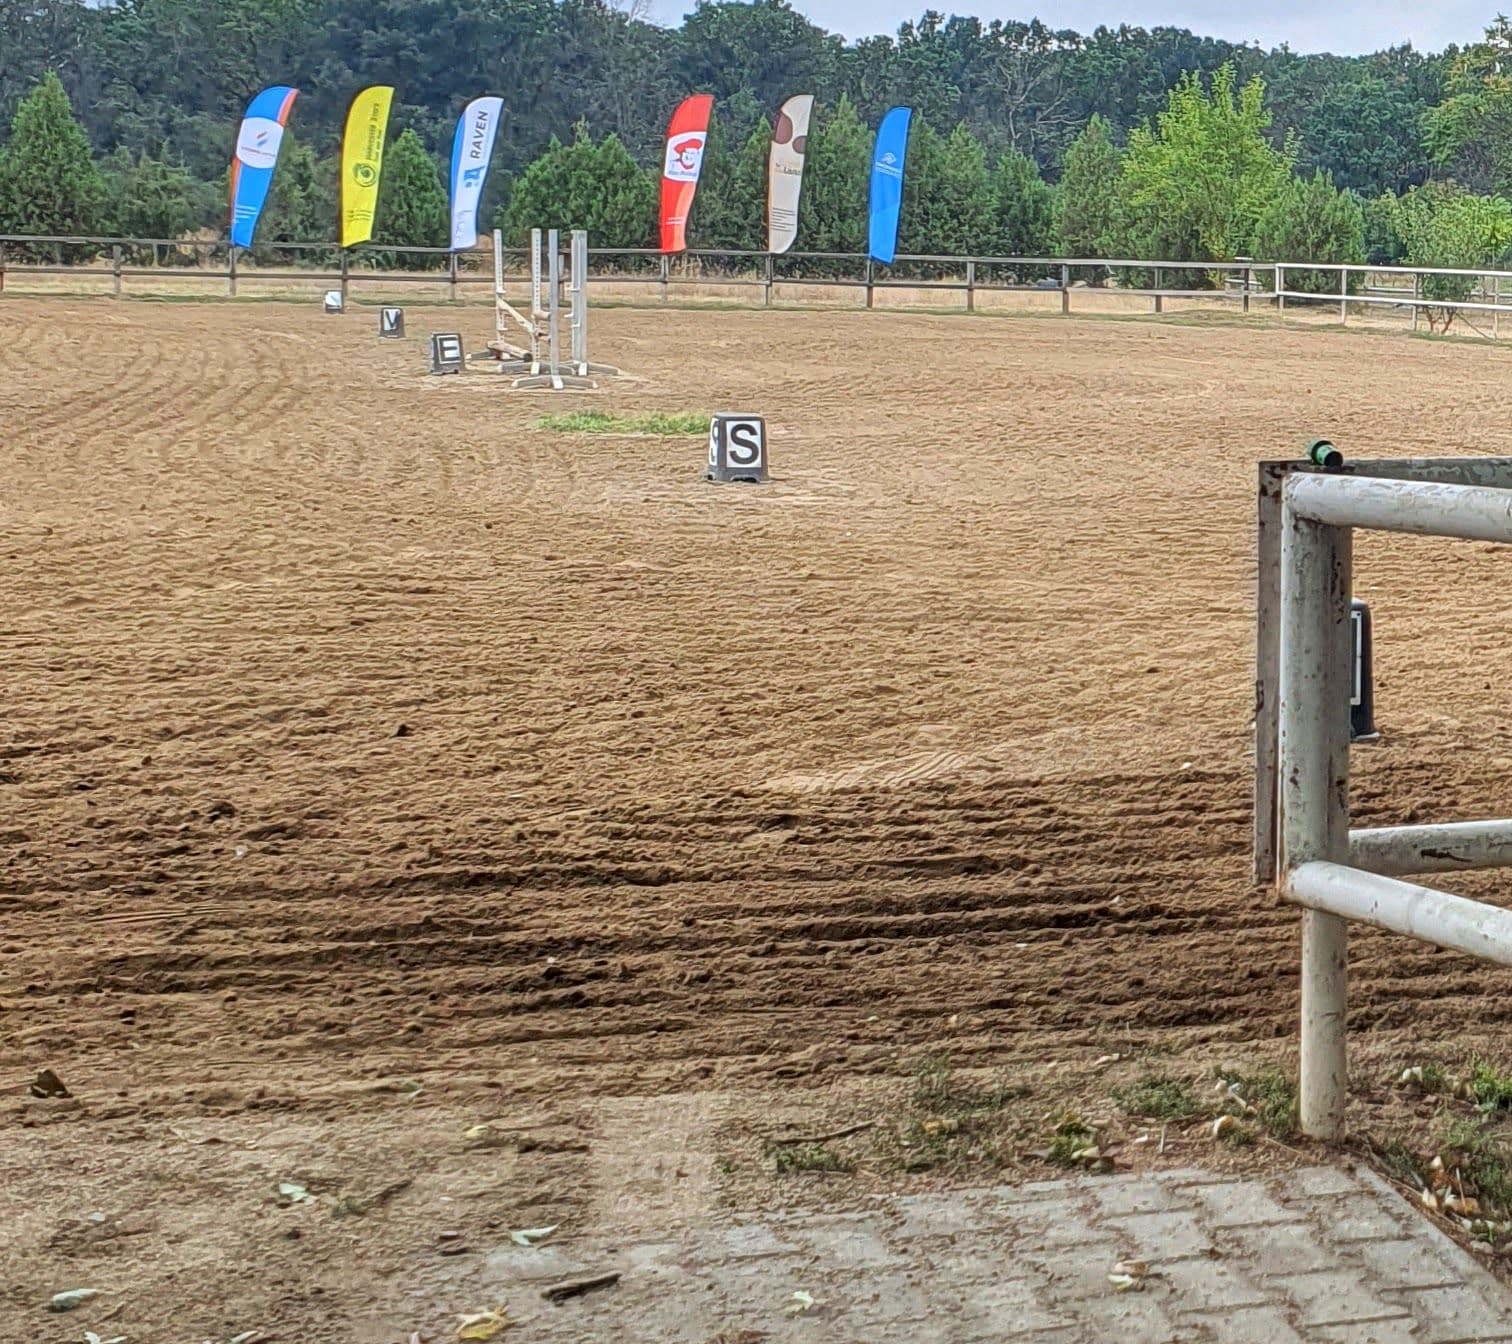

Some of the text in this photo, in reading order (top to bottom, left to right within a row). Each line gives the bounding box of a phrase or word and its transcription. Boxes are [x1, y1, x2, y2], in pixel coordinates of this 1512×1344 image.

[470, 109, 489, 160] RAVEN
[438, 336, 460, 361] E
[729, 423, 759, 465] S
